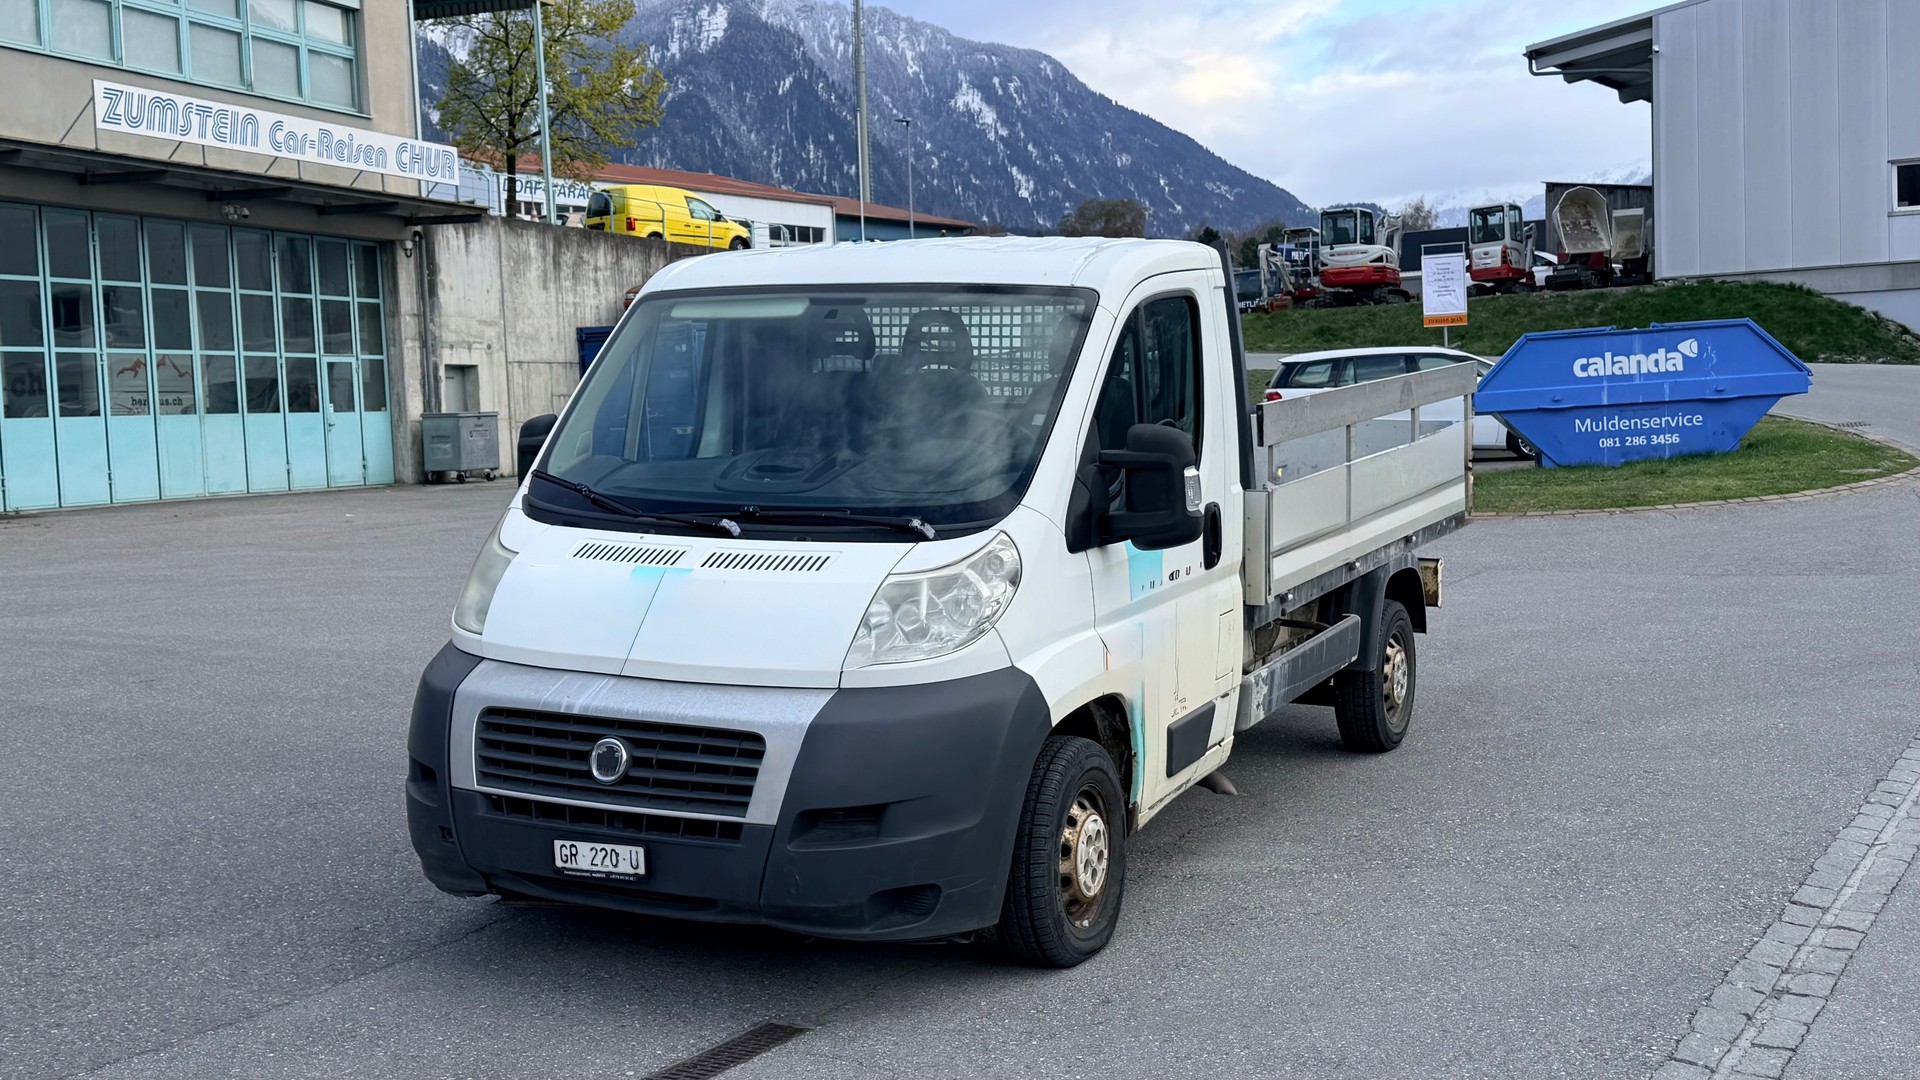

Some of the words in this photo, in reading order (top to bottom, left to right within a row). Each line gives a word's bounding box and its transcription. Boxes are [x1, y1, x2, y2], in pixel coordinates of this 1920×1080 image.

[101, 87, 259, 148] ZUMSTEIN
[268, 120, 388, 170] Car-Reisen
[395, 142, 456, 181] CHUR
[1573, 348, 1684, 378] calanda
[1575, 412, 1703, 433] Muldenservice
[1599, 437, 1621, 448] 081
[1625, 435, 1647, 446] 286
[1650, 433, 1680, 445] 3456
[559, 843, 578, 866] GR
[590, 847, 619, 869] 220
[629, 850, 639, 871] U
